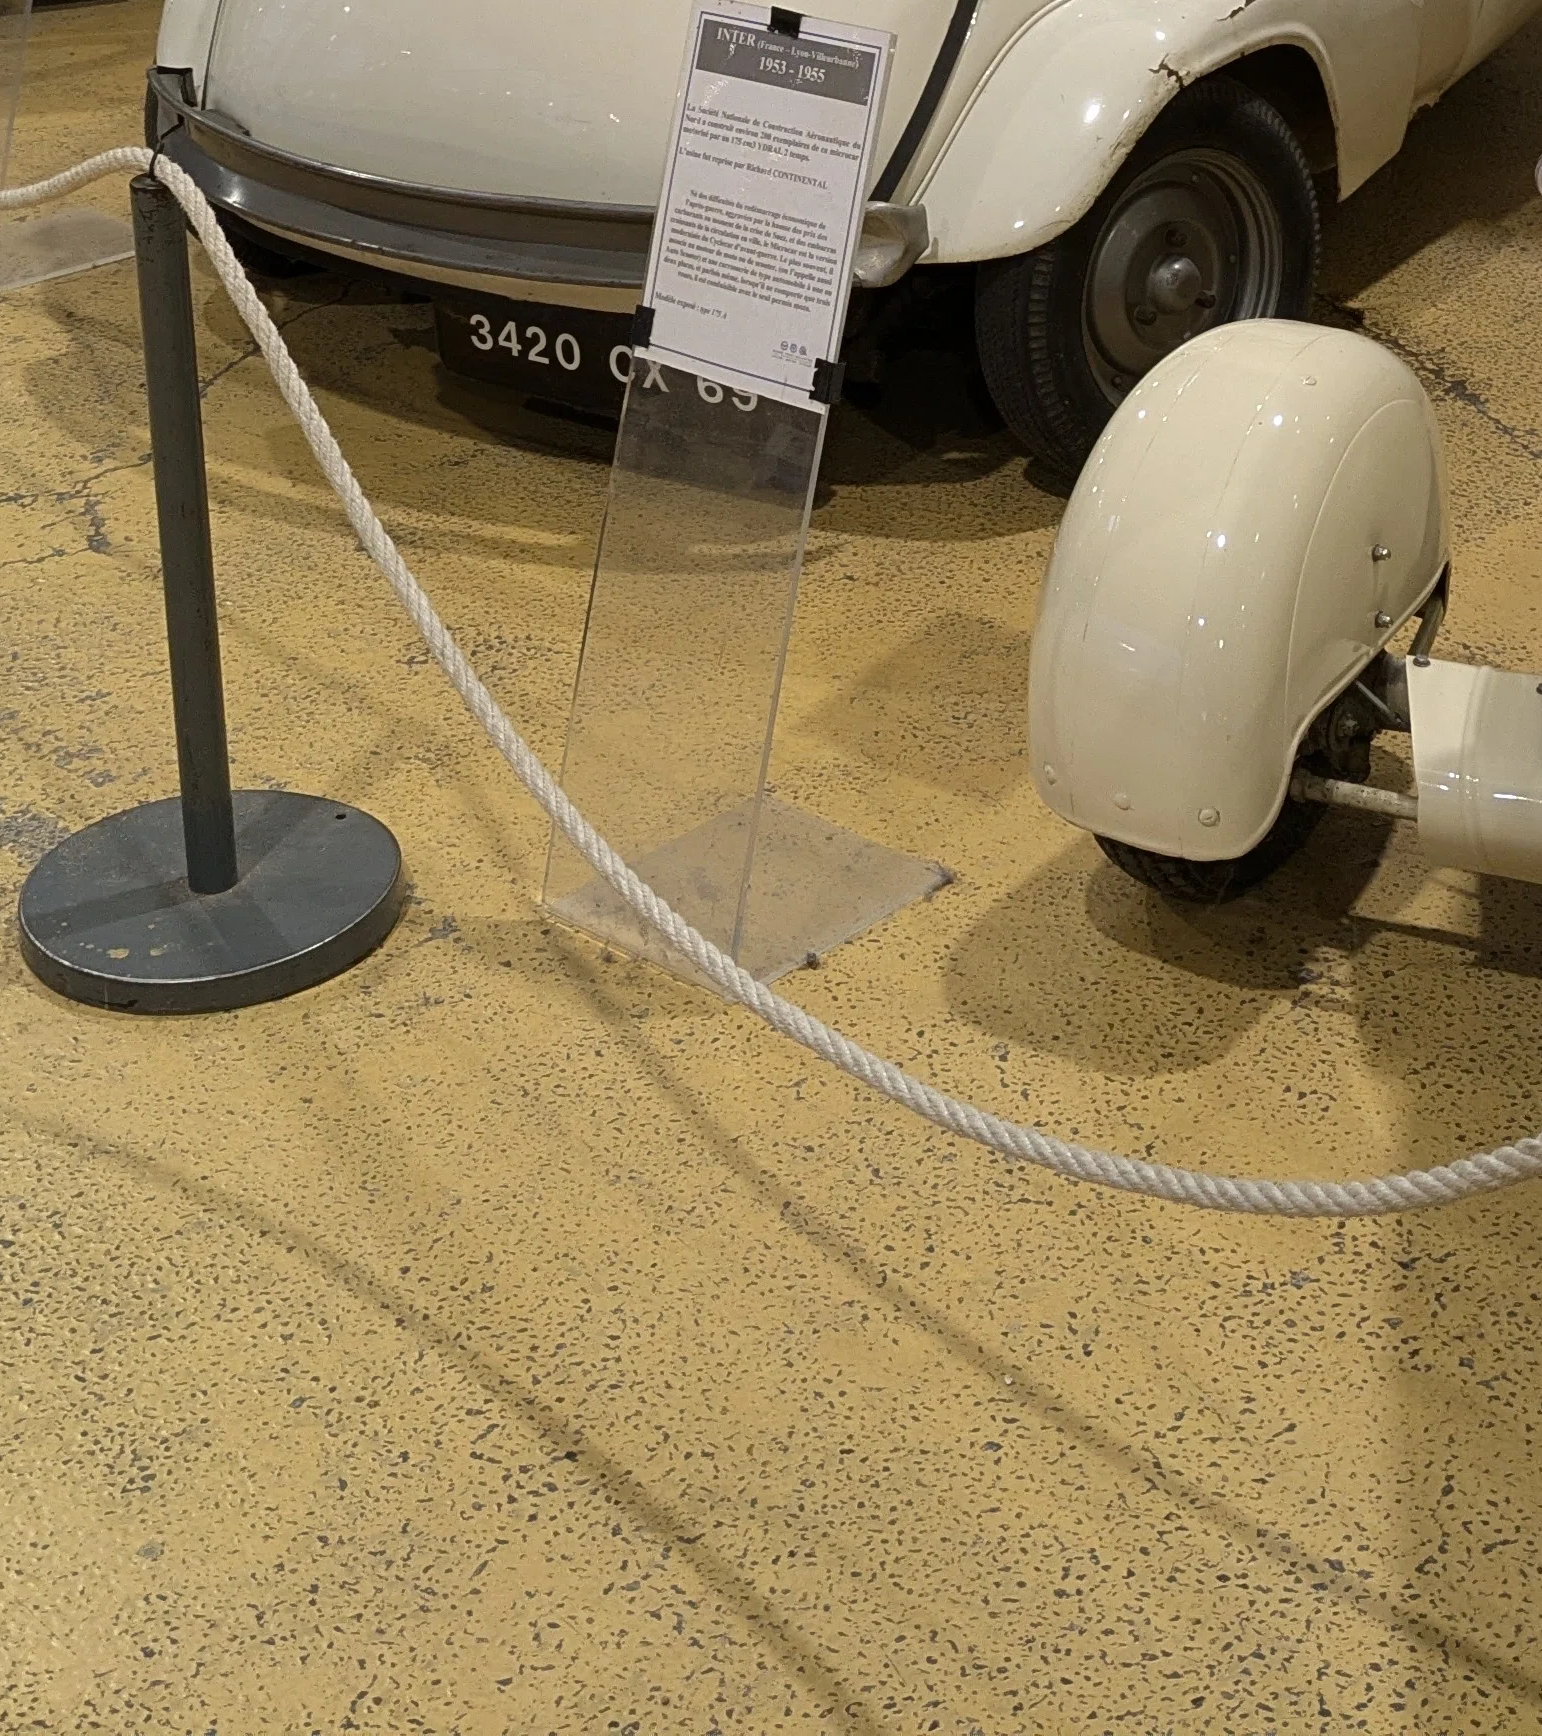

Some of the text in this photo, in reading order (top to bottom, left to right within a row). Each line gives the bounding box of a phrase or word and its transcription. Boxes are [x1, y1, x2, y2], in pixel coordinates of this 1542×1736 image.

[716, 27, 756, 47] INTER
[756, 39, 784, 52] (France
[759, 55, 787, 75] 1953
[797, 63, 826, 83] 1955
[682, 126, 709, 137] motorisé
[709, 132, 720, 141] par
[783, 148, 788, 156] 2
[789, 149, 809, 162] temps.
[683, 113, 701, 124] Nord
[706, 121, 734, 132] construit
[734, 127, 758, 137] environ
[772, 135, 810, 149] exemplaires
[810, 142, 819, 151] de
[829, 148, 859, 160] microcar
[686, 102, 695, 111] La
[720, 110, 750, 124] Nationale
[752, 117, 760, 126] de
[762, 119, 803, 136] Construction
[805, 129, 850, 147] Aéronautique
[851, 140, 861, 149] du
[702, 151, 711, 161] fut
[711, 156, 733, 166] reprise
[733, 161, 745, 170] par
[746, 162, 772, 175] Richard
[772, 168, 828, 189] CONTINENTAL
[674, 208, 703, 219] carburants
[712, 217, 734, 227] moment
[749, 227, 762, 235] crise
[764, 229, 771, 237] de
[772, 232, 787, 242] Suez,
[796, 238, 806, 246] des
[807, 241, 836, 253] embarras
[708, 194, 734, 206] difficultés
[743, 204, 780, 219] redémarrage
[781, 213, 817, 228] économique
[818, 222, 826, 230] de
[725, 210, 752, 221] aggravées
[752, 217, 763, 225] par
[771, 221, 791, 231] hausse
[791, 226, 801, 234] des
[802, 230, 815, 238] prix
[816, 232, 827, 240] des
[670, 217, 696, 228] croissants
[710, 227, 739, 239] circulation
[748, 237, 762, 246] ville,
[770, 242, 797, 254] Microcar
[815, 254, 837, 265] version
[670, 227, 700, 239] modernisée
[701, 234, 708, 242] du
[709, 236, 733, 248] Cyclecar
[788, 258, 801, 266] plus
[802, 262, 827, 274] souvent,
[663, 255, 676, 264] deux
[677, 260, 694, 270] places,
[701, 267, 720, 276] parfois
[774, 286, 803, 299] comporte
[803, 294, 815, 302] que
[816, 297, 830, 306] trois
[665, 246, 678, 255] Auto
[718, 261, 749, 273] carrosserie
[772, 275, 805, 288] automobile
[695, 244, 715, 254] moteur
[715, 248, 722, 256] de
[723, 251, 737, 260] moto
[746, 256, 754, 264] de
[816, 276, 832, 285] aussi
[654, 291, 675, 304] Modèle
[677, 271, 692, 281] roues,
[737, 287, 751, 295] avec
[758, 293, 770, 301] seul
[771, 296, 792, 306] permis
[792, 302, 810, 312] moto.
[469, 314, 581, 371] 3420
[609, 344, 669, 393] CX
